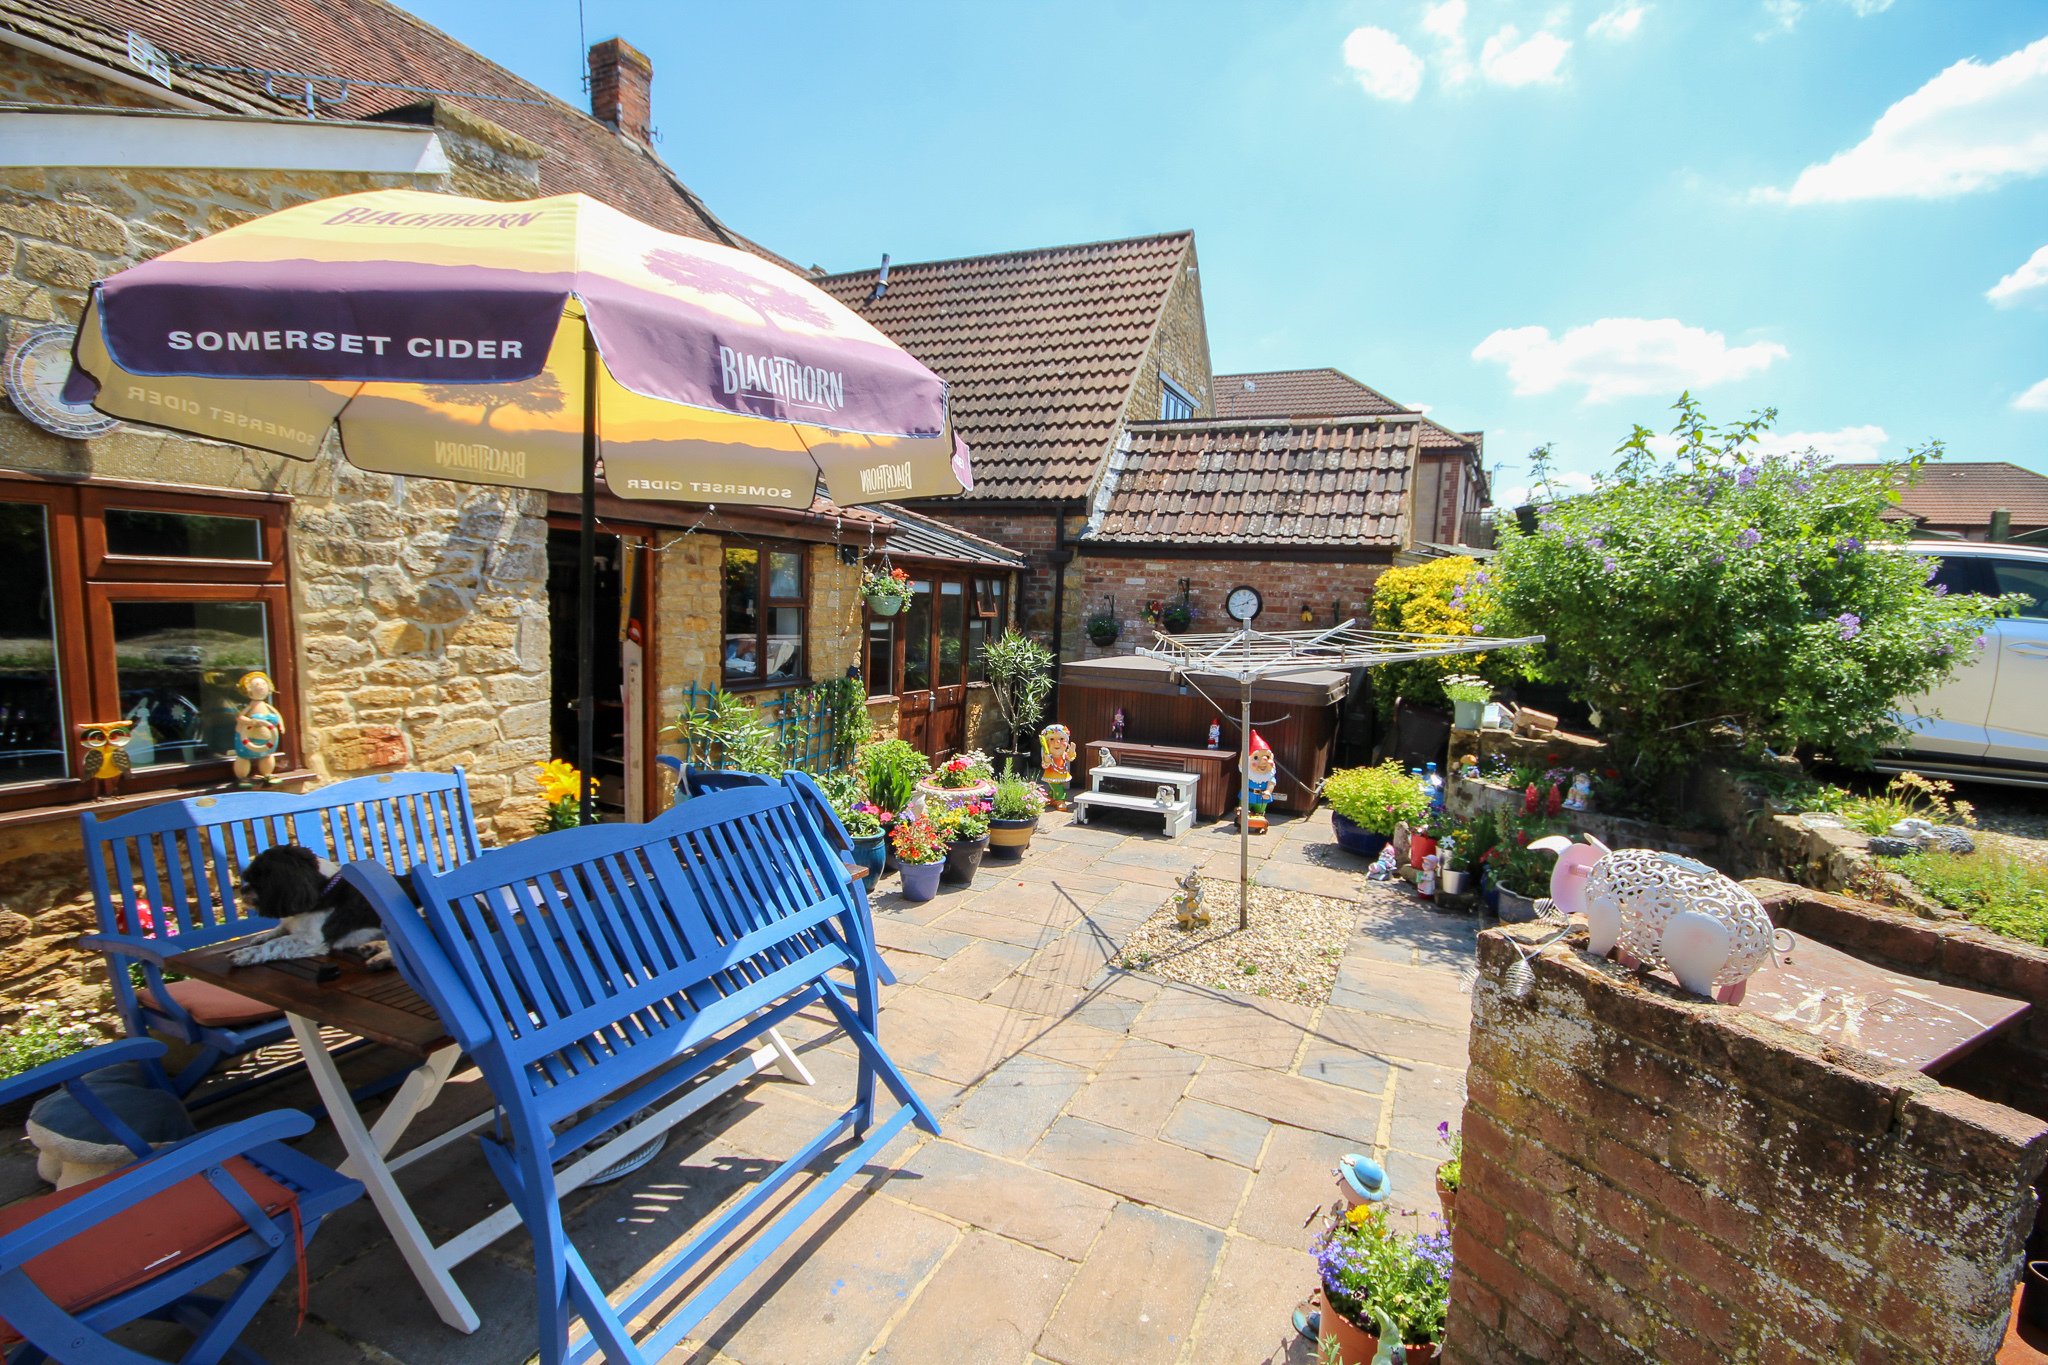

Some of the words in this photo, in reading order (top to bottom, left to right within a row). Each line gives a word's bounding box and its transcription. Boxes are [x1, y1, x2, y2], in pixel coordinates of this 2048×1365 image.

[322, 206, 544, 230] BLACKTHORN
[168, 330, 392, 356] SOMERSET
[407, 337, 523, 359] CIDER
[720, 345, 844, 412] BLACKTHORN
